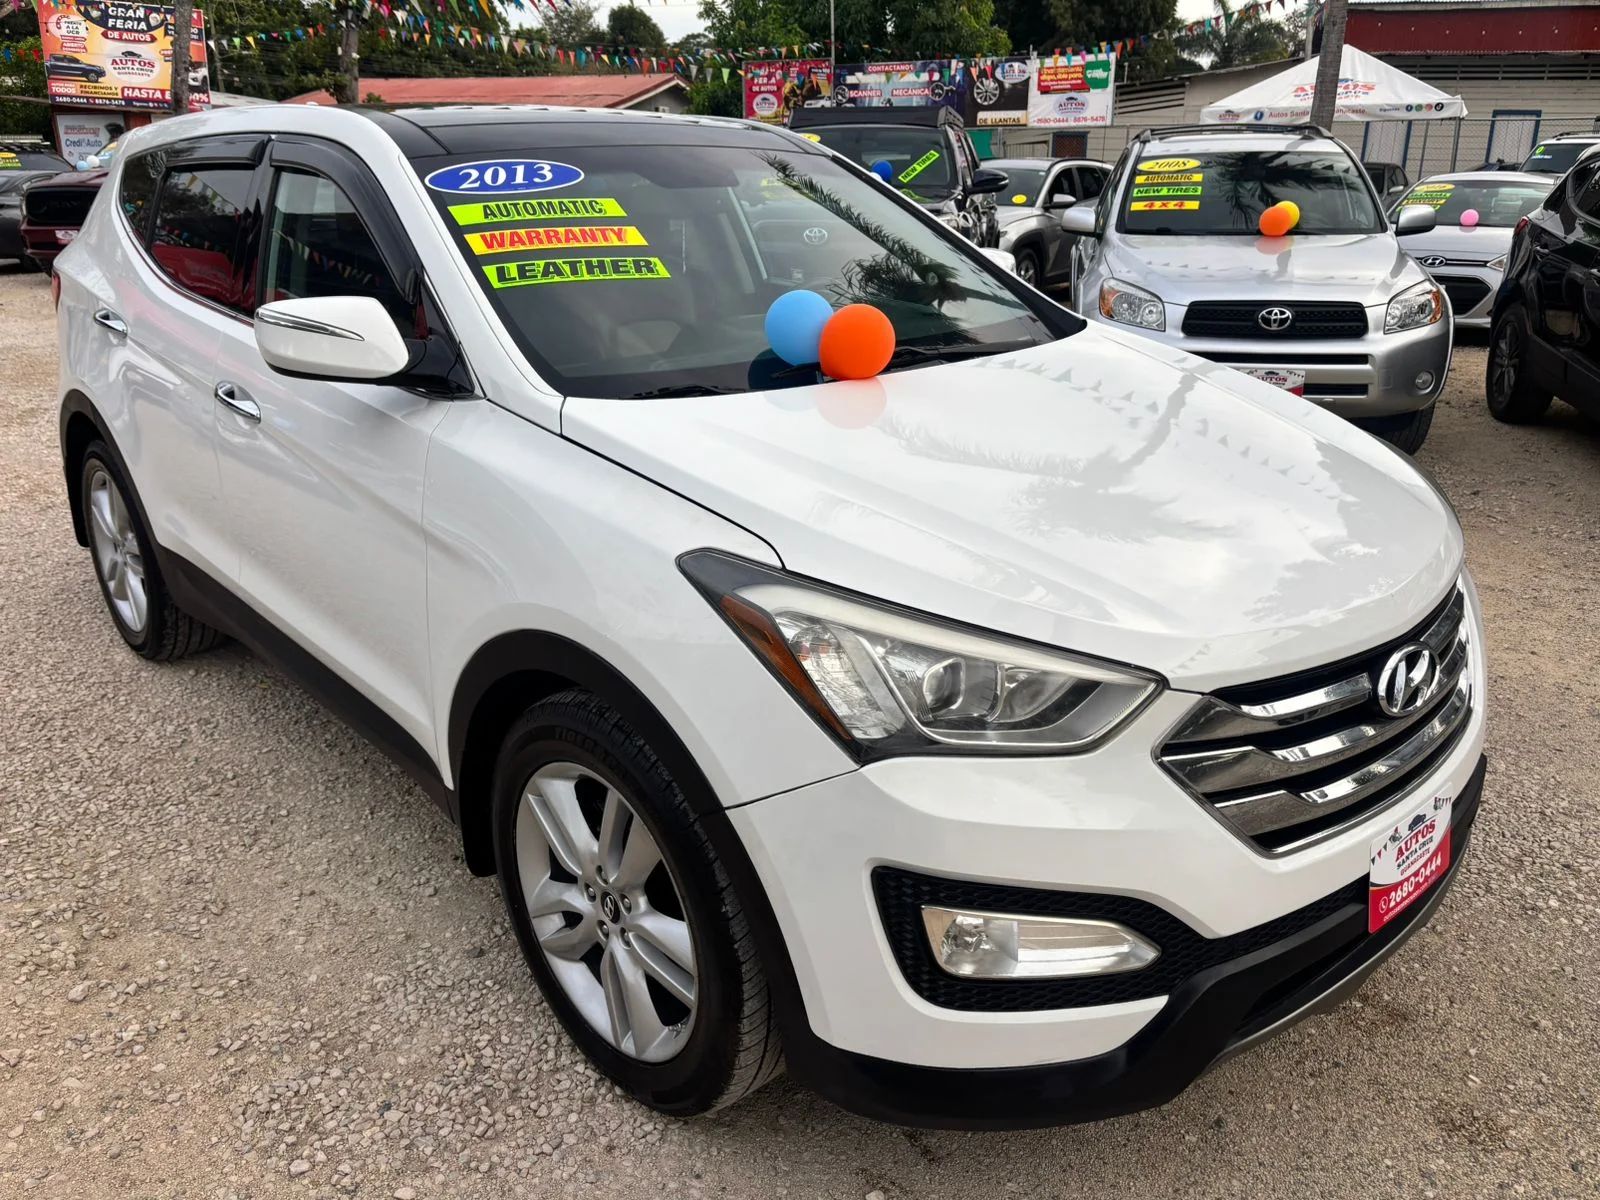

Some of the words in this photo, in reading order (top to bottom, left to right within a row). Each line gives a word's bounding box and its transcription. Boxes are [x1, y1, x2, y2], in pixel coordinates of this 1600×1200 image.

[108, 7, 145, 18] GRAN
[108, 18, 148, 30] FERIA
[107, 31, 118, 39] DE
[119, 32, 151, 41] AUTOS
[111, 58, 155, 69] AUTOS
[123, 88, 162, 98] HASTA
[459, 163, 553, 189] 2013
[901, 166, 917, 180] NEW
[916, 152, 936, 168] TIRES
[1149, 160, 1190, 171] 2008
[1144, 174, 1193, 182] AUTOMATIC
[1136, 187, 1162, 195] NEW
[482, 199, 607, 220] AUTOMATIC
[480, 226, 628, 249] WARRANTY
[495, 258, 658, 283] LEATHER
[1395, 819, 1436, 862] AUTOS
[1396, 850, 1418, 870] SANTA
[1418, 836, 1433, 853] CRUZ
[1400, 847, 1430, 876] GUANACASTE
[1389, 851, 1442, 908] 2680-0444
